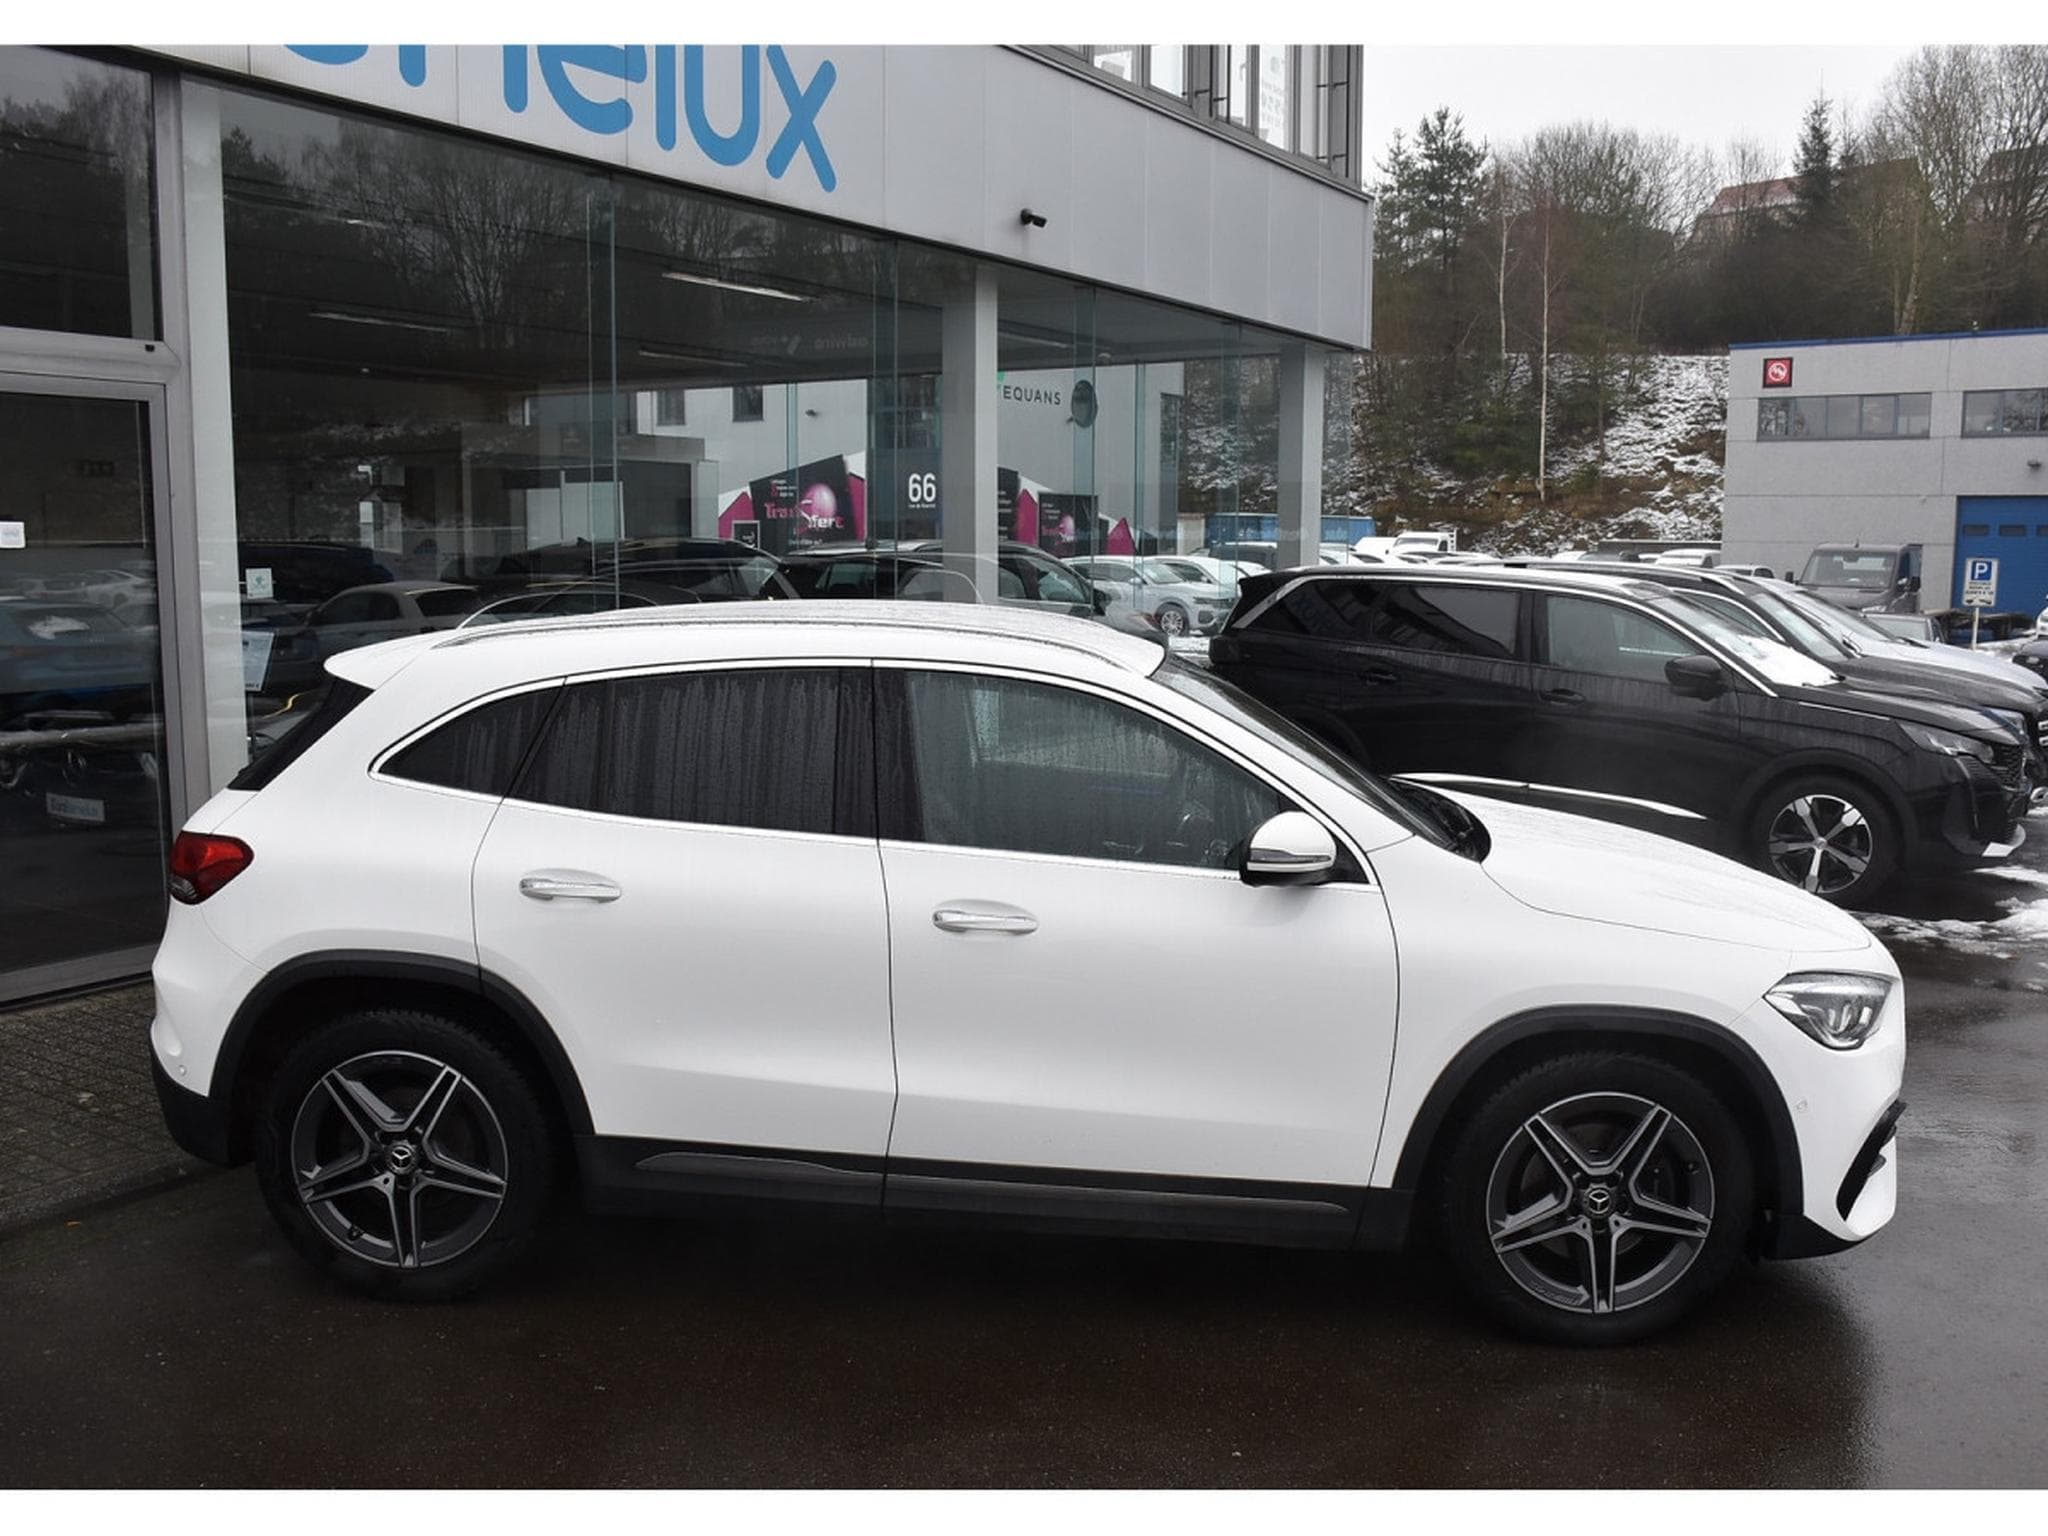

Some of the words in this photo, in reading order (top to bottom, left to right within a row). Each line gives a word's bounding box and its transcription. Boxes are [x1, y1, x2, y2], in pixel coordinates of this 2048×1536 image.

[1003, 385, 1061, 405] EQUANS
[908, 472, 936, 502] 66
[1974, 562, 1988, 580] P
